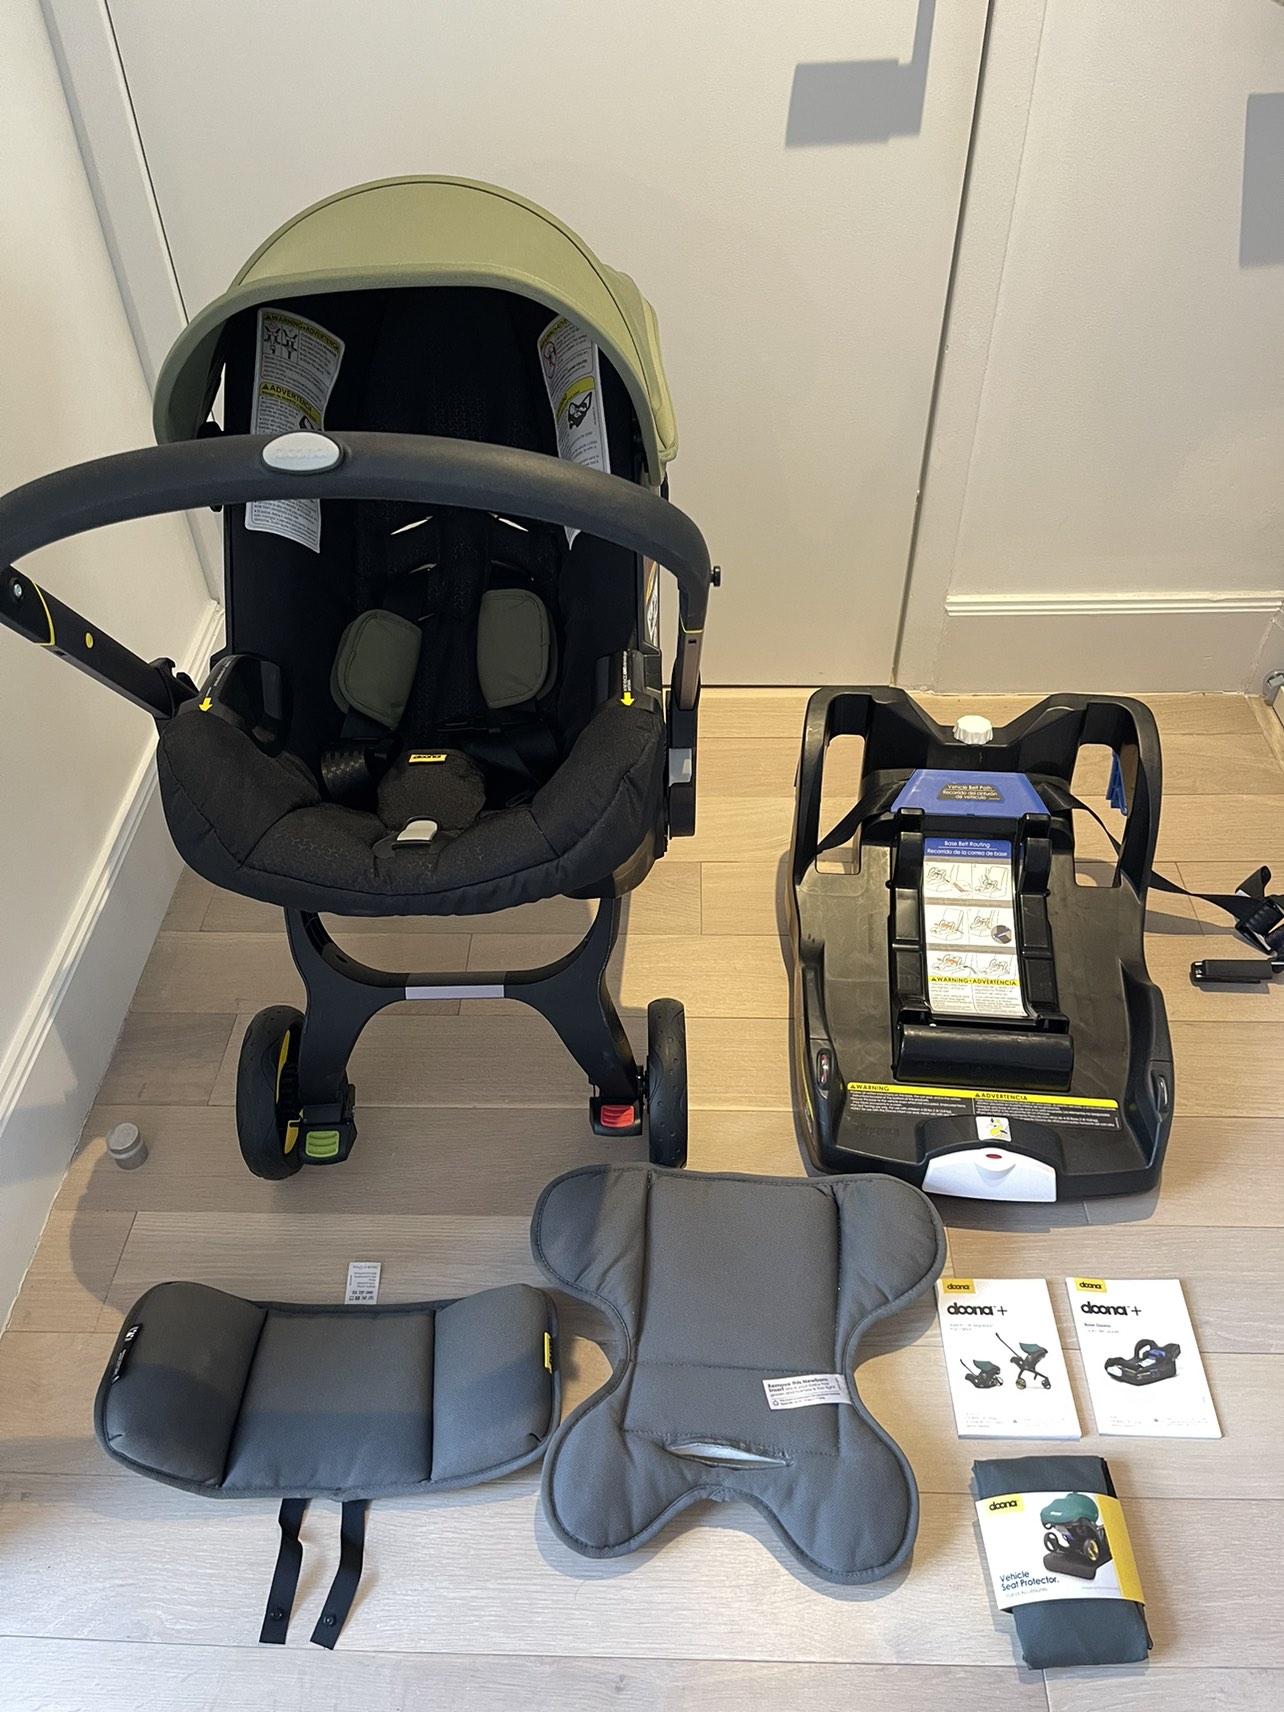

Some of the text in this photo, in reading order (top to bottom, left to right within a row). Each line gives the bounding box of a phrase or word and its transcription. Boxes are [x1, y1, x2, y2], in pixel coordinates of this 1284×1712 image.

[969, 841, 990, 849] Routing
[1079, 1282, 1102, 1290] doona
[989, 1500, 1018, 1511] doona
[999, 1571, 1029, 1583] Vehicle
[1001, 1576, 1060, 1592] Seat Protector.
